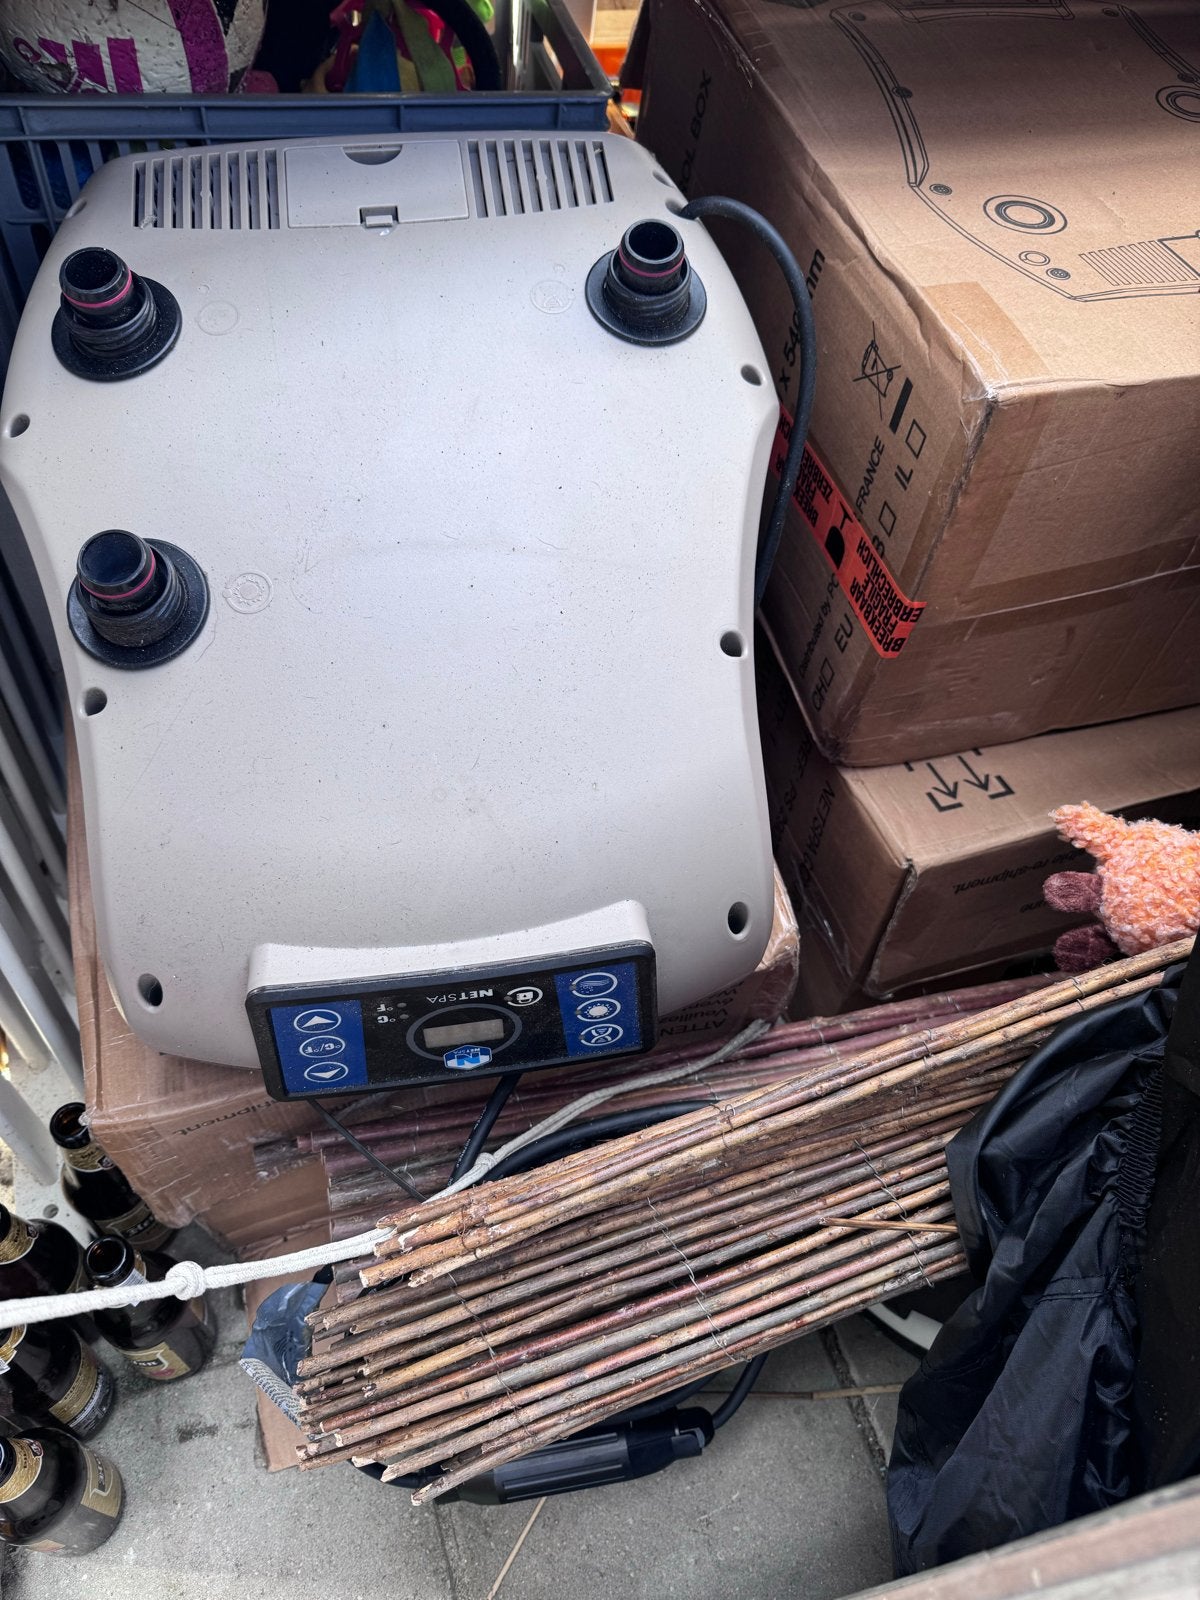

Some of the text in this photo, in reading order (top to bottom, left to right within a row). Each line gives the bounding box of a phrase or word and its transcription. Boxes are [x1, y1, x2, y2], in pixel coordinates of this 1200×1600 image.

[690, 68, 712, 140] BOX
[856, 435, 885, 515] FRANCE
[811, 675, 828, 712] CH
[834, 613, 853, 654] EU
[894, 465, 914, 492] IL
[856, 536, 925, 623] ERBRECHLICH
[861, 572, 898, 636] FRAGILE
[849, 577, 907, 652] BREEKBAAR
[376, 1003, 394, 1012] °F
[376, 1015, 396, 1024] °C
[426, 988, 494, 1004] NETSPA
[660, 1018, 727, 1037] ATTEN
